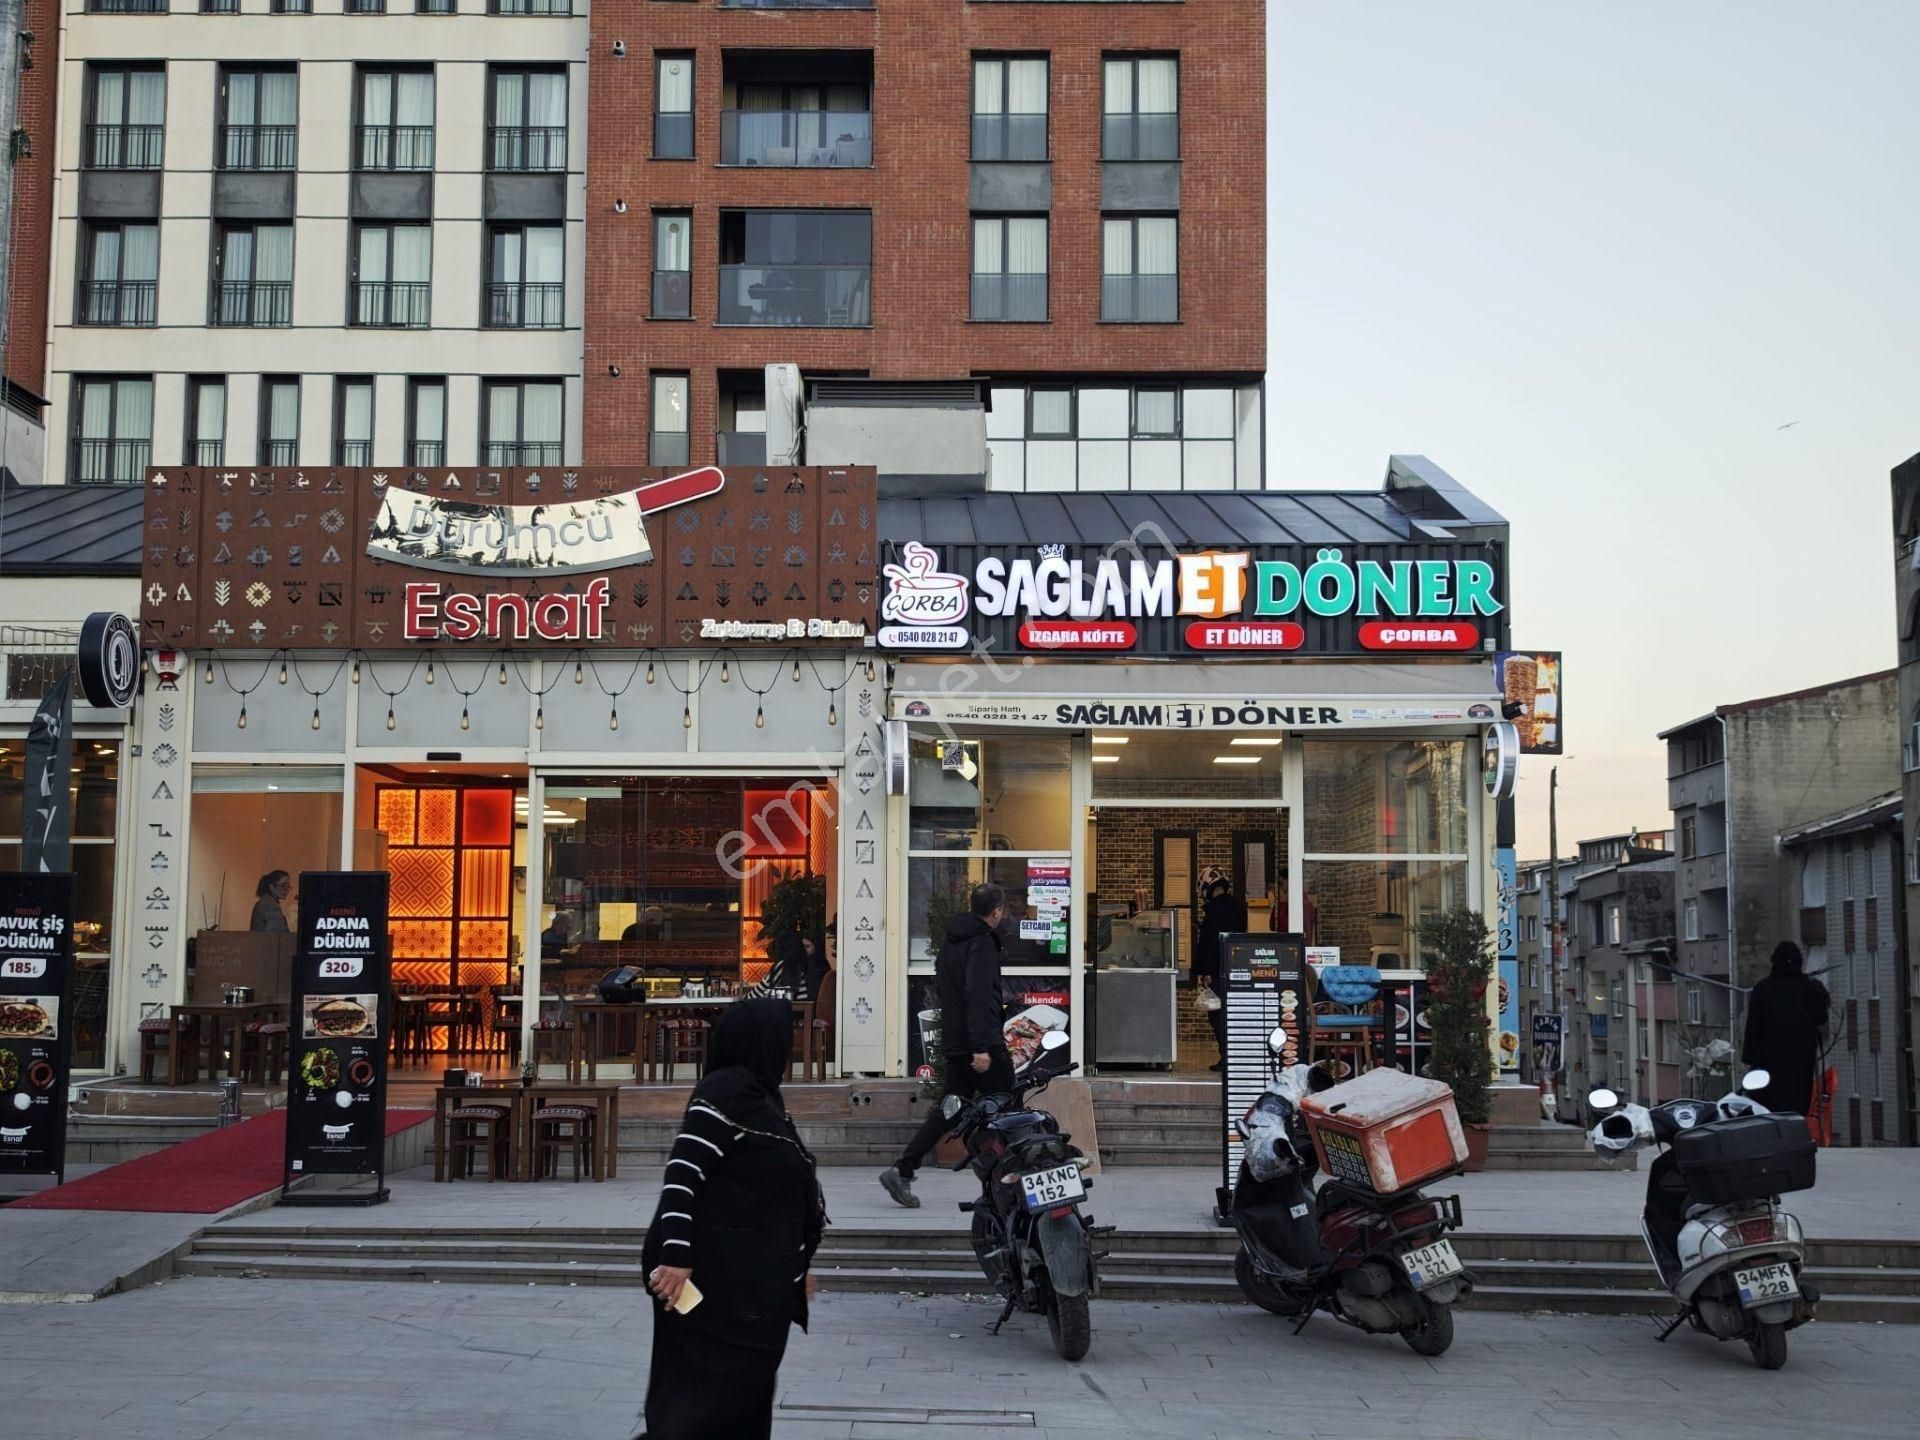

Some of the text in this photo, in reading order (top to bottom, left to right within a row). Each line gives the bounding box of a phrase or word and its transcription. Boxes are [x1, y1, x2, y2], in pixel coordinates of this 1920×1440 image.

[1177, 553, 1249, 615] ET
[1254, 548, 1504, 617] DÖNER
[404, 576, 609, 639] Esnaf
[886, 594, 958, 616] ÇORBA
[787, 618, 806, 638] Et
[807, 618, 865, 638] Dürüm
[898, 631, 958, 643] 0540 028 21 47
[1029, 630, 1079, 643] IZGARA
[1206, 626, 1283, 645] ET DÖNER
[1380, 629, 1458, 644] ÇORBA
[1212, 700, 1343, 725] DÖNER
[42, 914, 64, 934] ŞİŞ
[316, 917, 369, 930] ADANA
[1021, 921, 1051, 931] SETCARD
[0, 932, 54, 950] DÜRÜM
[314, 932, 370, 949] DÜRÜM
[1251, 968, 1277, 978] MENÜ
[1024, 993, 1063, 1004] İskender
[1025, 1166, 1077, 1190] 34 KNC
[1040, 1185, 1067, 1202] 152
[1424, 1258, 1450, 1279] 521
[1758, 1280, 1790, 1298] 228
